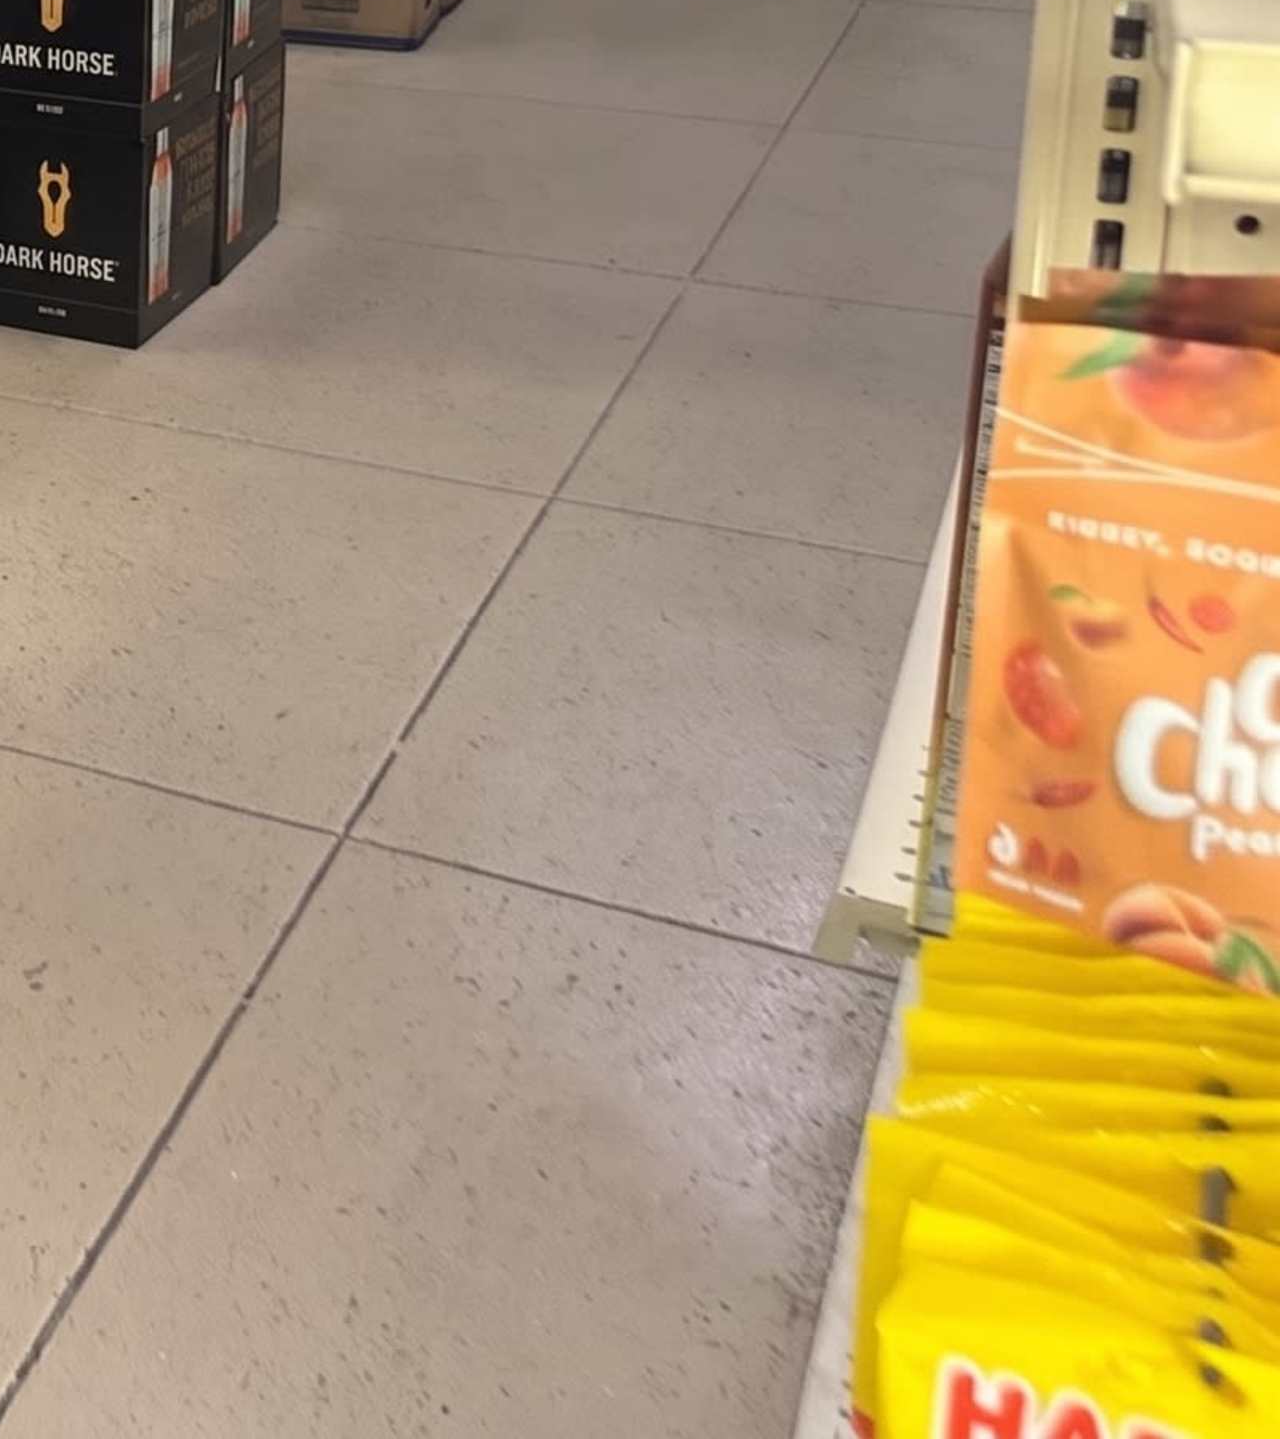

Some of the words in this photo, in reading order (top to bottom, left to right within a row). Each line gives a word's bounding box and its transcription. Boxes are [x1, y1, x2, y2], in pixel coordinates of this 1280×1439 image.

[47, 47, 116, 76] HORSE
[49, 250, 116, 282] HORSE
[1113, 674, 1280, 821] Ch
